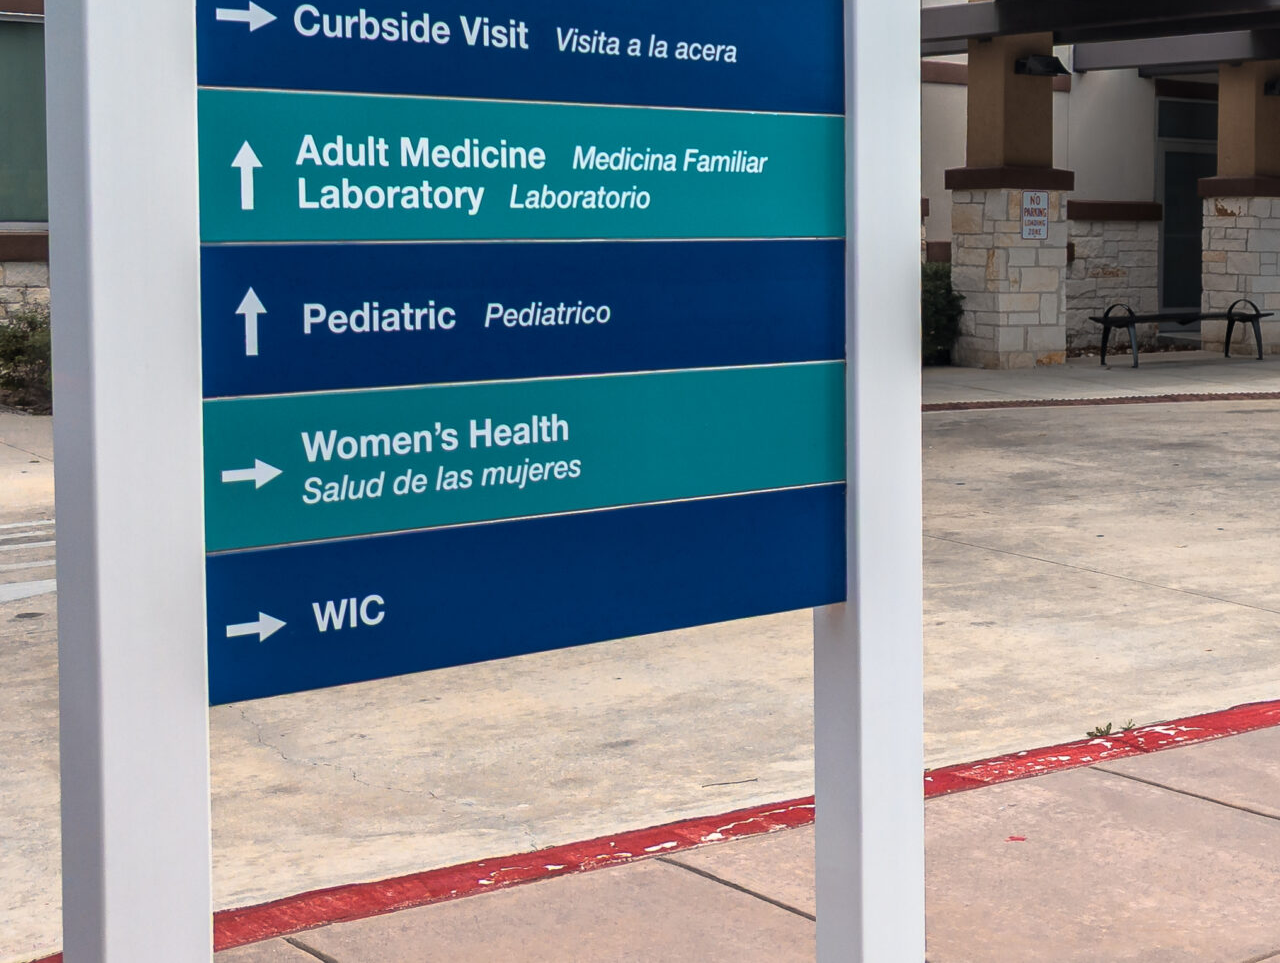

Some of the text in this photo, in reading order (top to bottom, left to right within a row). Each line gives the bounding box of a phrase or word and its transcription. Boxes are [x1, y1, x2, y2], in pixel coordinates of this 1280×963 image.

[293, 4, 529, 49] Curbside Visit
[556, 27, 737, 63] Visita a la acera
[295, 134, 546, 170] Adult Medicine
[572, 145, 769, 174] Medicina Familiar
[298, 177, 485, 216] Laboratory
[509, 184, 651, 209] Laboratorio
[1024, 207, 1047, 217] PARKING
[1030, 195, 1041, 206] NO
[303, 300, 456, 335] Pediatric
[484, 301, 611, 328] Pediatrico
[301, 413, 569, 463] Women's Health
[302, 459, 582, 505] Salud de las mujeres
[312, 594, 385, 632] WIC
